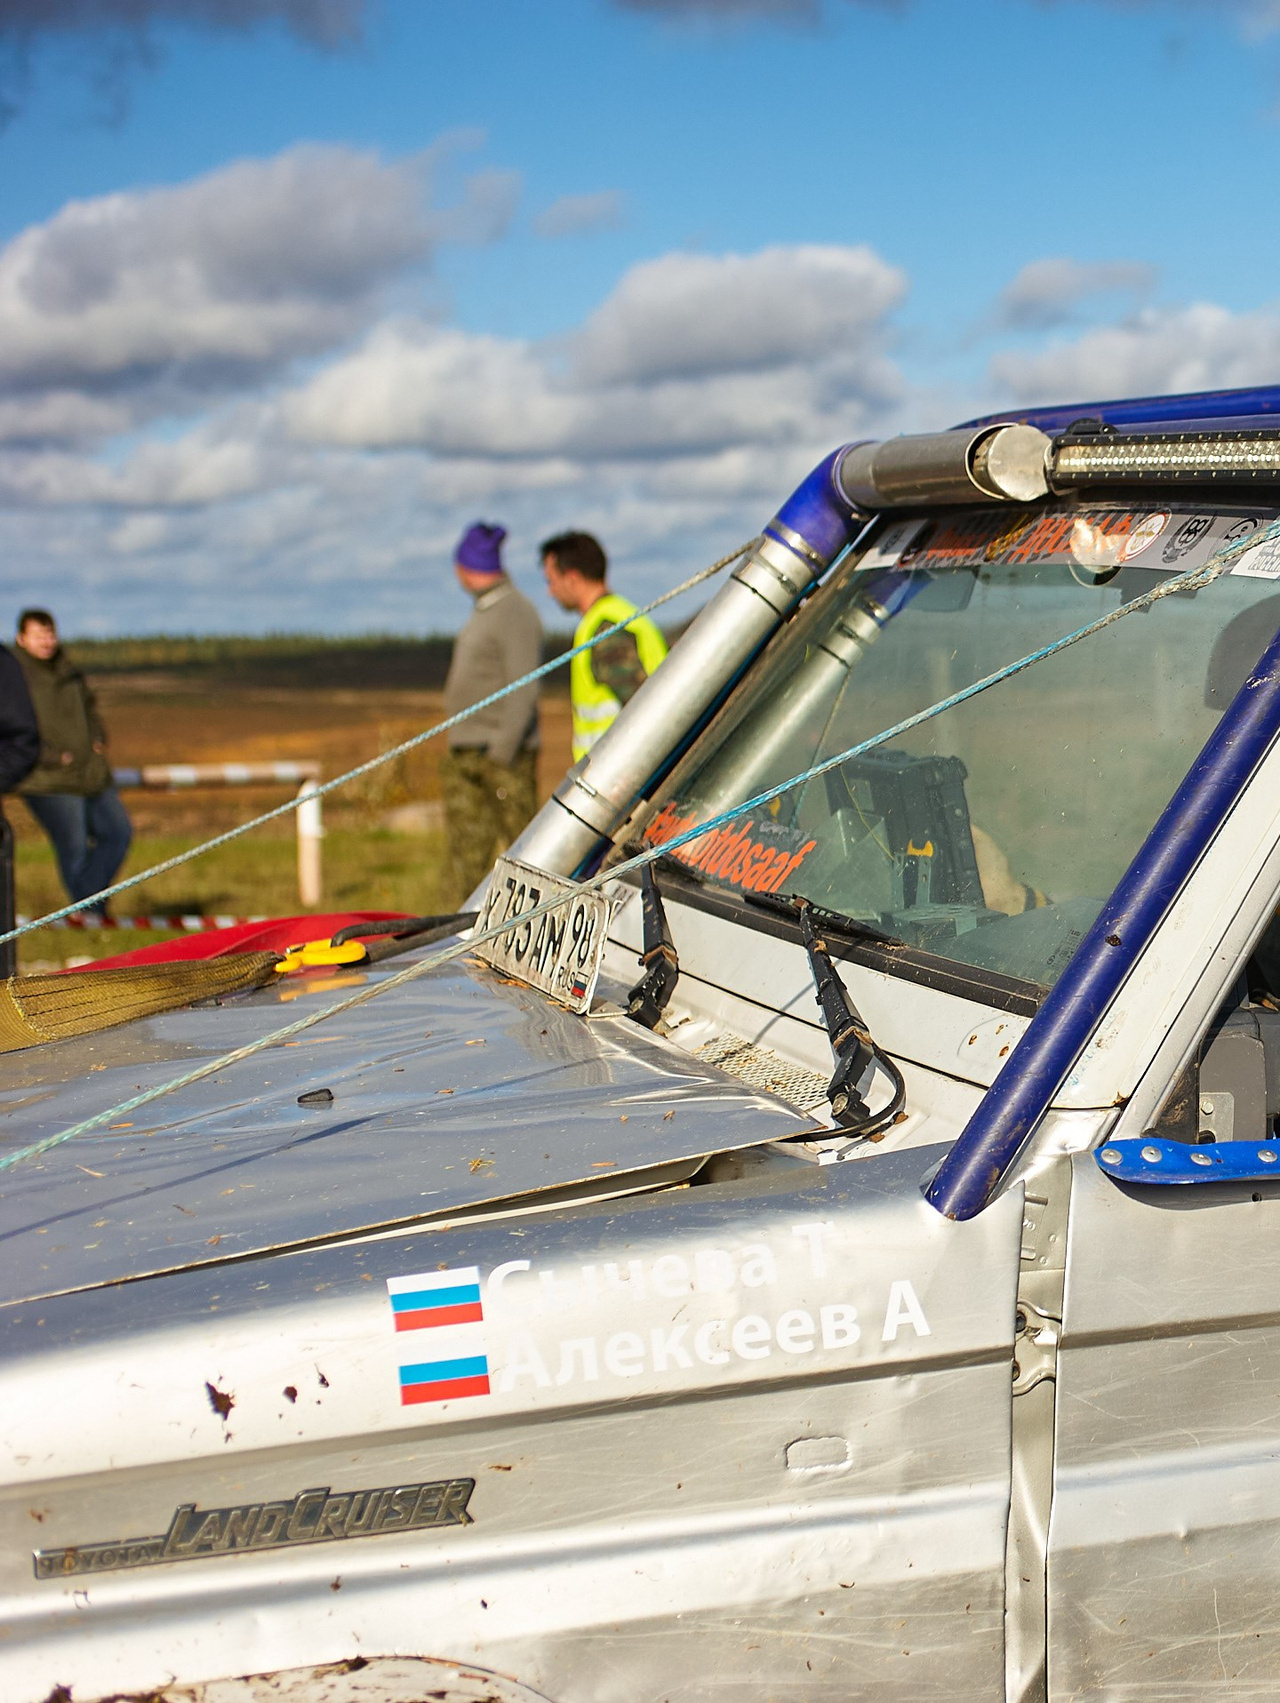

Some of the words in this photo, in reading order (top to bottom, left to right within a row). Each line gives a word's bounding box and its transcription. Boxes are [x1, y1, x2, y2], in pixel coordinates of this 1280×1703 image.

[556, 965, 576, 992] RUS
[486, 1242, 777, 1322] Сычева
[792, 1220, 837, 1280] Т
[498, 1302, 862, 1393] Алексеев
[881, 1279, 933, 1342] А
